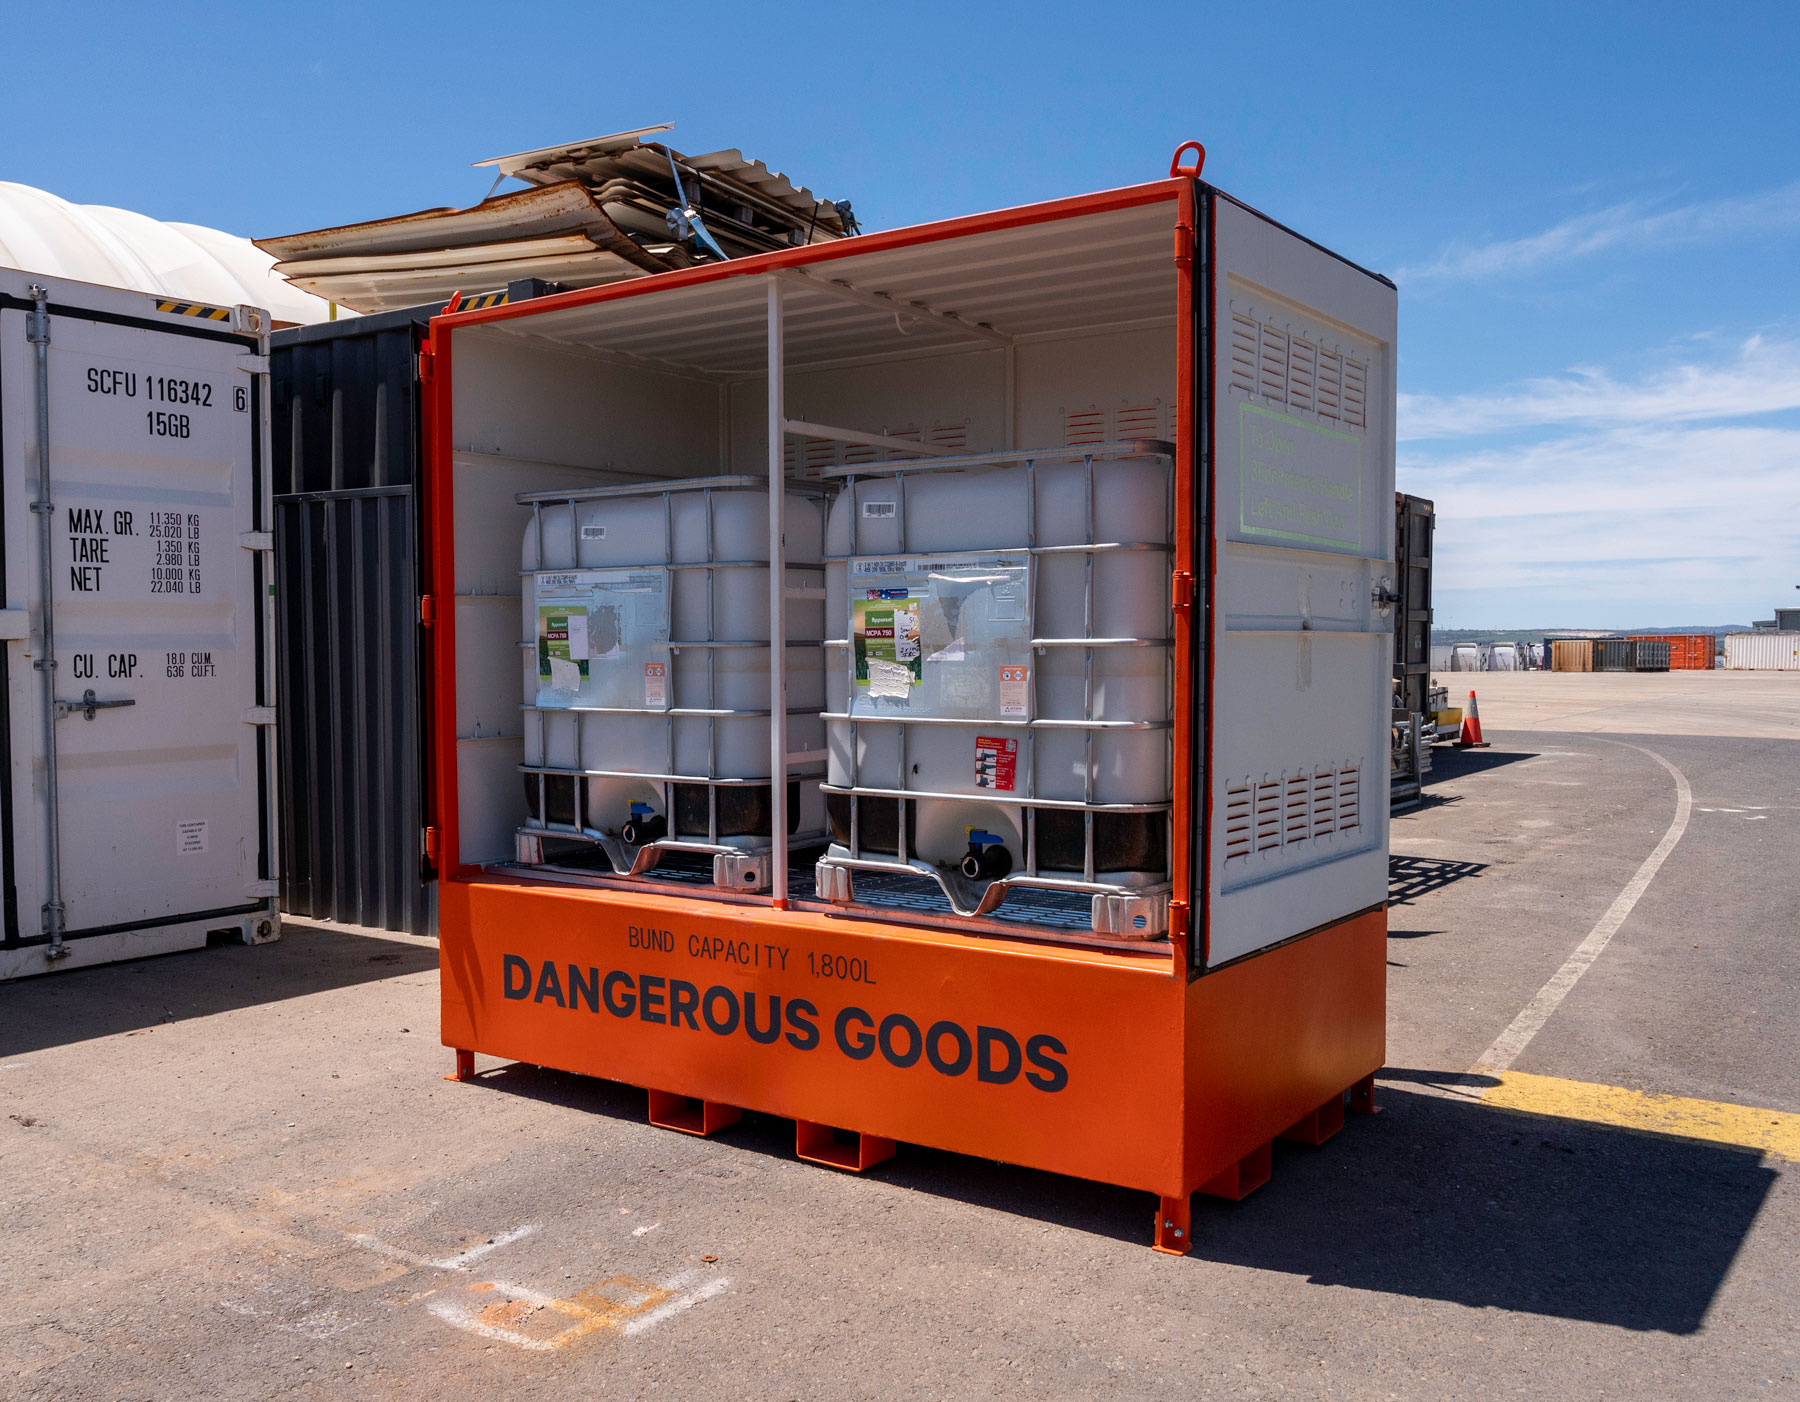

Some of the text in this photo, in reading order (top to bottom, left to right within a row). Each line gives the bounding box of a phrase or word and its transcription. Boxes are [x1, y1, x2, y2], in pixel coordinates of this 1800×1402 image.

[87, 367, 246, 411] SCFU 116342 6
[146, 410, 190, 439] 15GB
[68, 508, 140, 537] MAX. GR.
[187, 513, 200, 527] KG
[188, 526, 200, 540] LB
[69, 537, 110, 564] TARE
[188, 541, 200, 554] KG
[188, 554, 200, 567] LB
[70, 566, 102, 592] NET
[189, 568, 201, 581] KG
[189, 581, 201, 594] LB
[73, 653, 144, 679] CU. CAP.
[166, 652, 186, 665] 18.0
[166, 665, 185, 678] 636
[628, 925, 877, 985] BUND CAPACITY 1,800L
[502, 953, 1069, 1093] DANGEROUS GOODS
